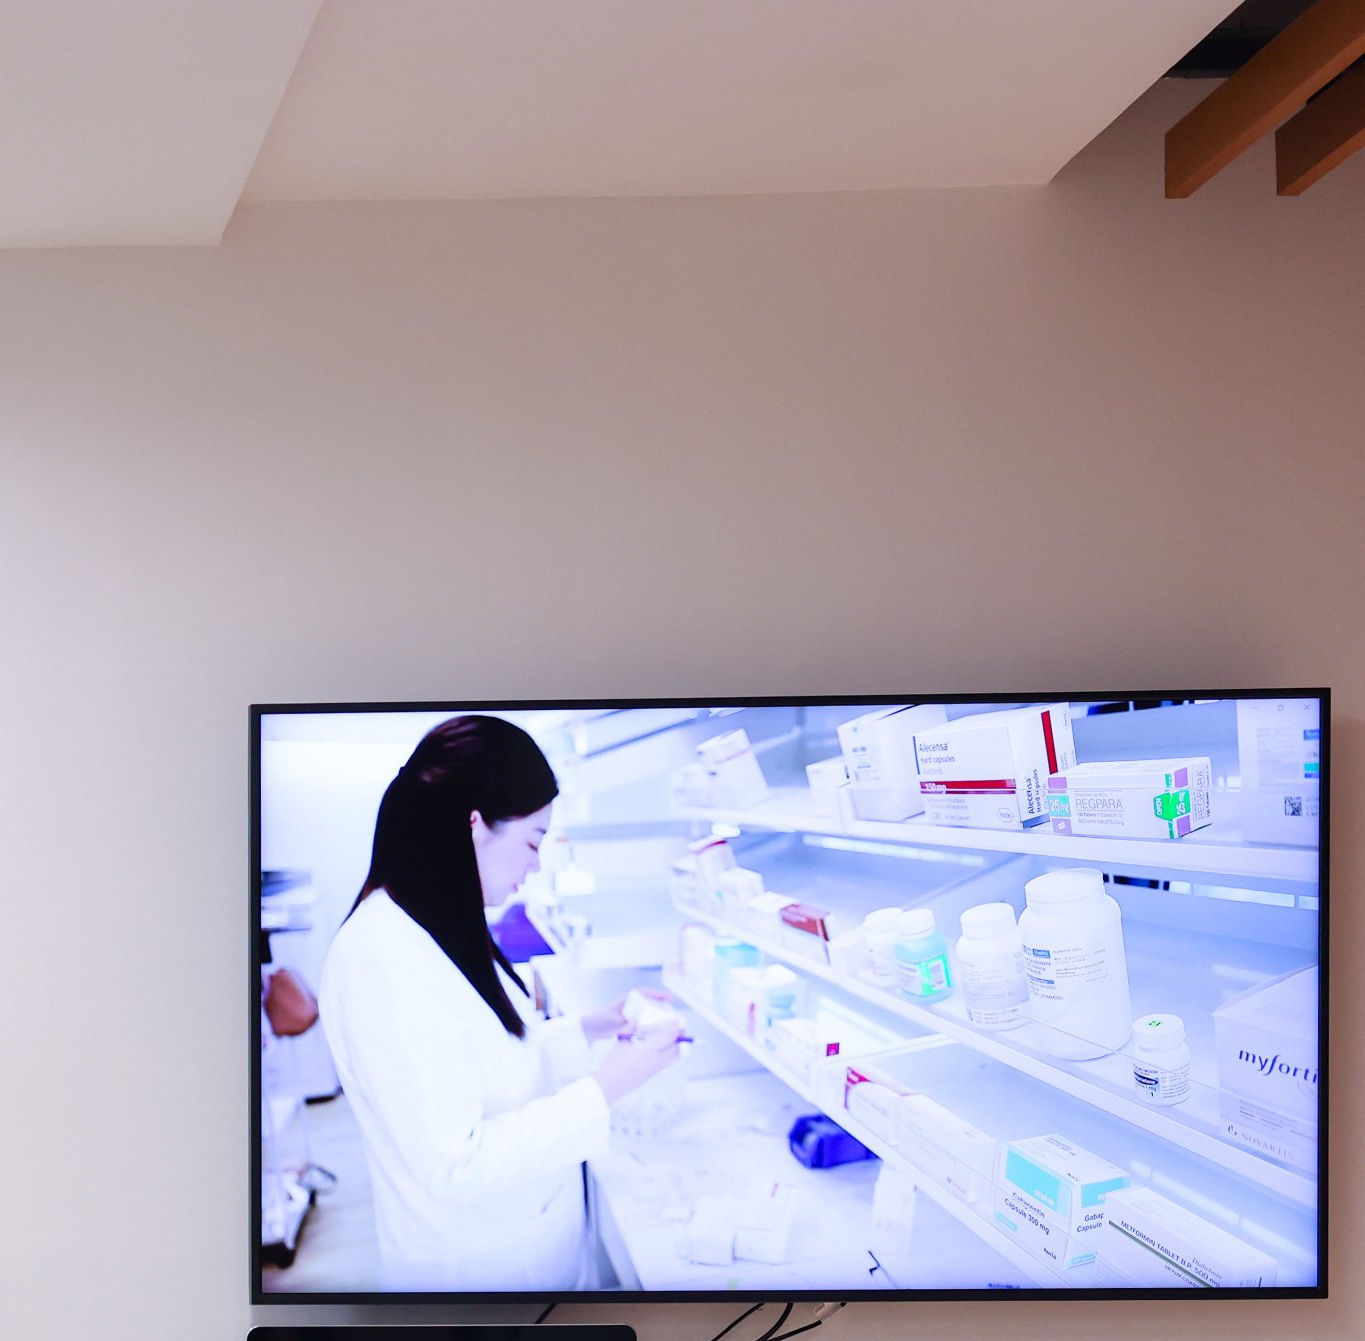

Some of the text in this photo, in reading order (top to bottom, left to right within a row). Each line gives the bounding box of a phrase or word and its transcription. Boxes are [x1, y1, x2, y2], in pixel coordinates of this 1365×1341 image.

[919, 742, 949, 752] Alecensa
[1074, 798, 1124, 810] REGPARA
[1004, 1198, 1050, 1235] Capsule 300 mg
[1120, 1220, 1209, 1280] METFORMIN TABLET 500
